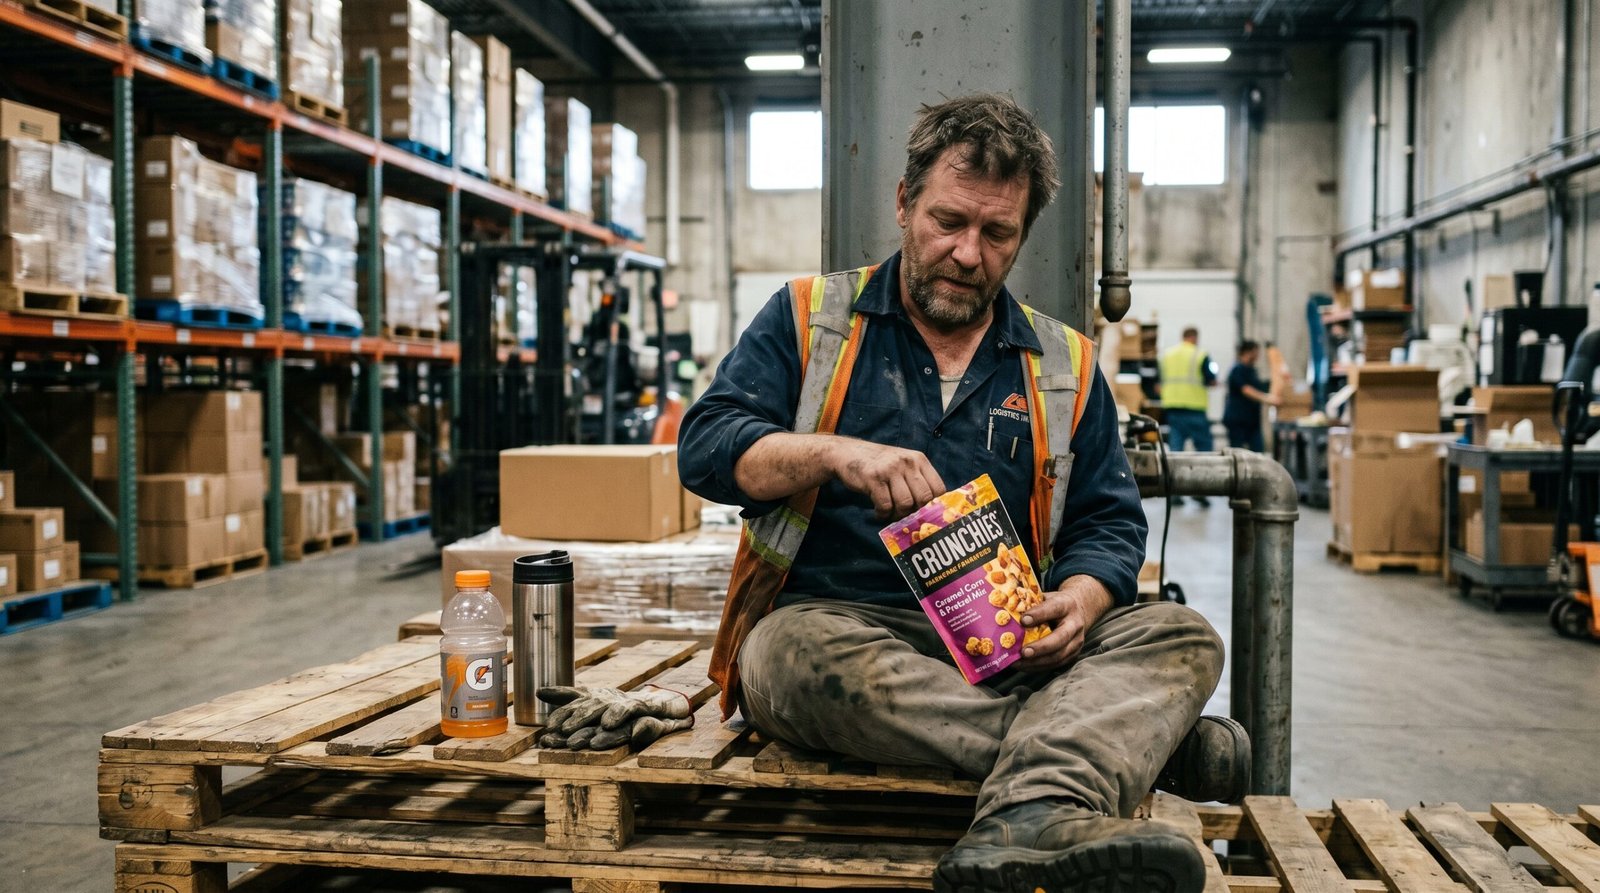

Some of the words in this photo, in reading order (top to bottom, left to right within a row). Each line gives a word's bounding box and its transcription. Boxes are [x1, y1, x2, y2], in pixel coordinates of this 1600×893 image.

[989, 407, 1020, 421] LOGISTICS
[911, 511, 1004, 579] CRUNCHIES
[935, 588, 965, 608] Caramel
[964, 579, 985, 592] Corn
[945, 594, 972, 614] Pretzel
[465, 657, 494, 691] G
